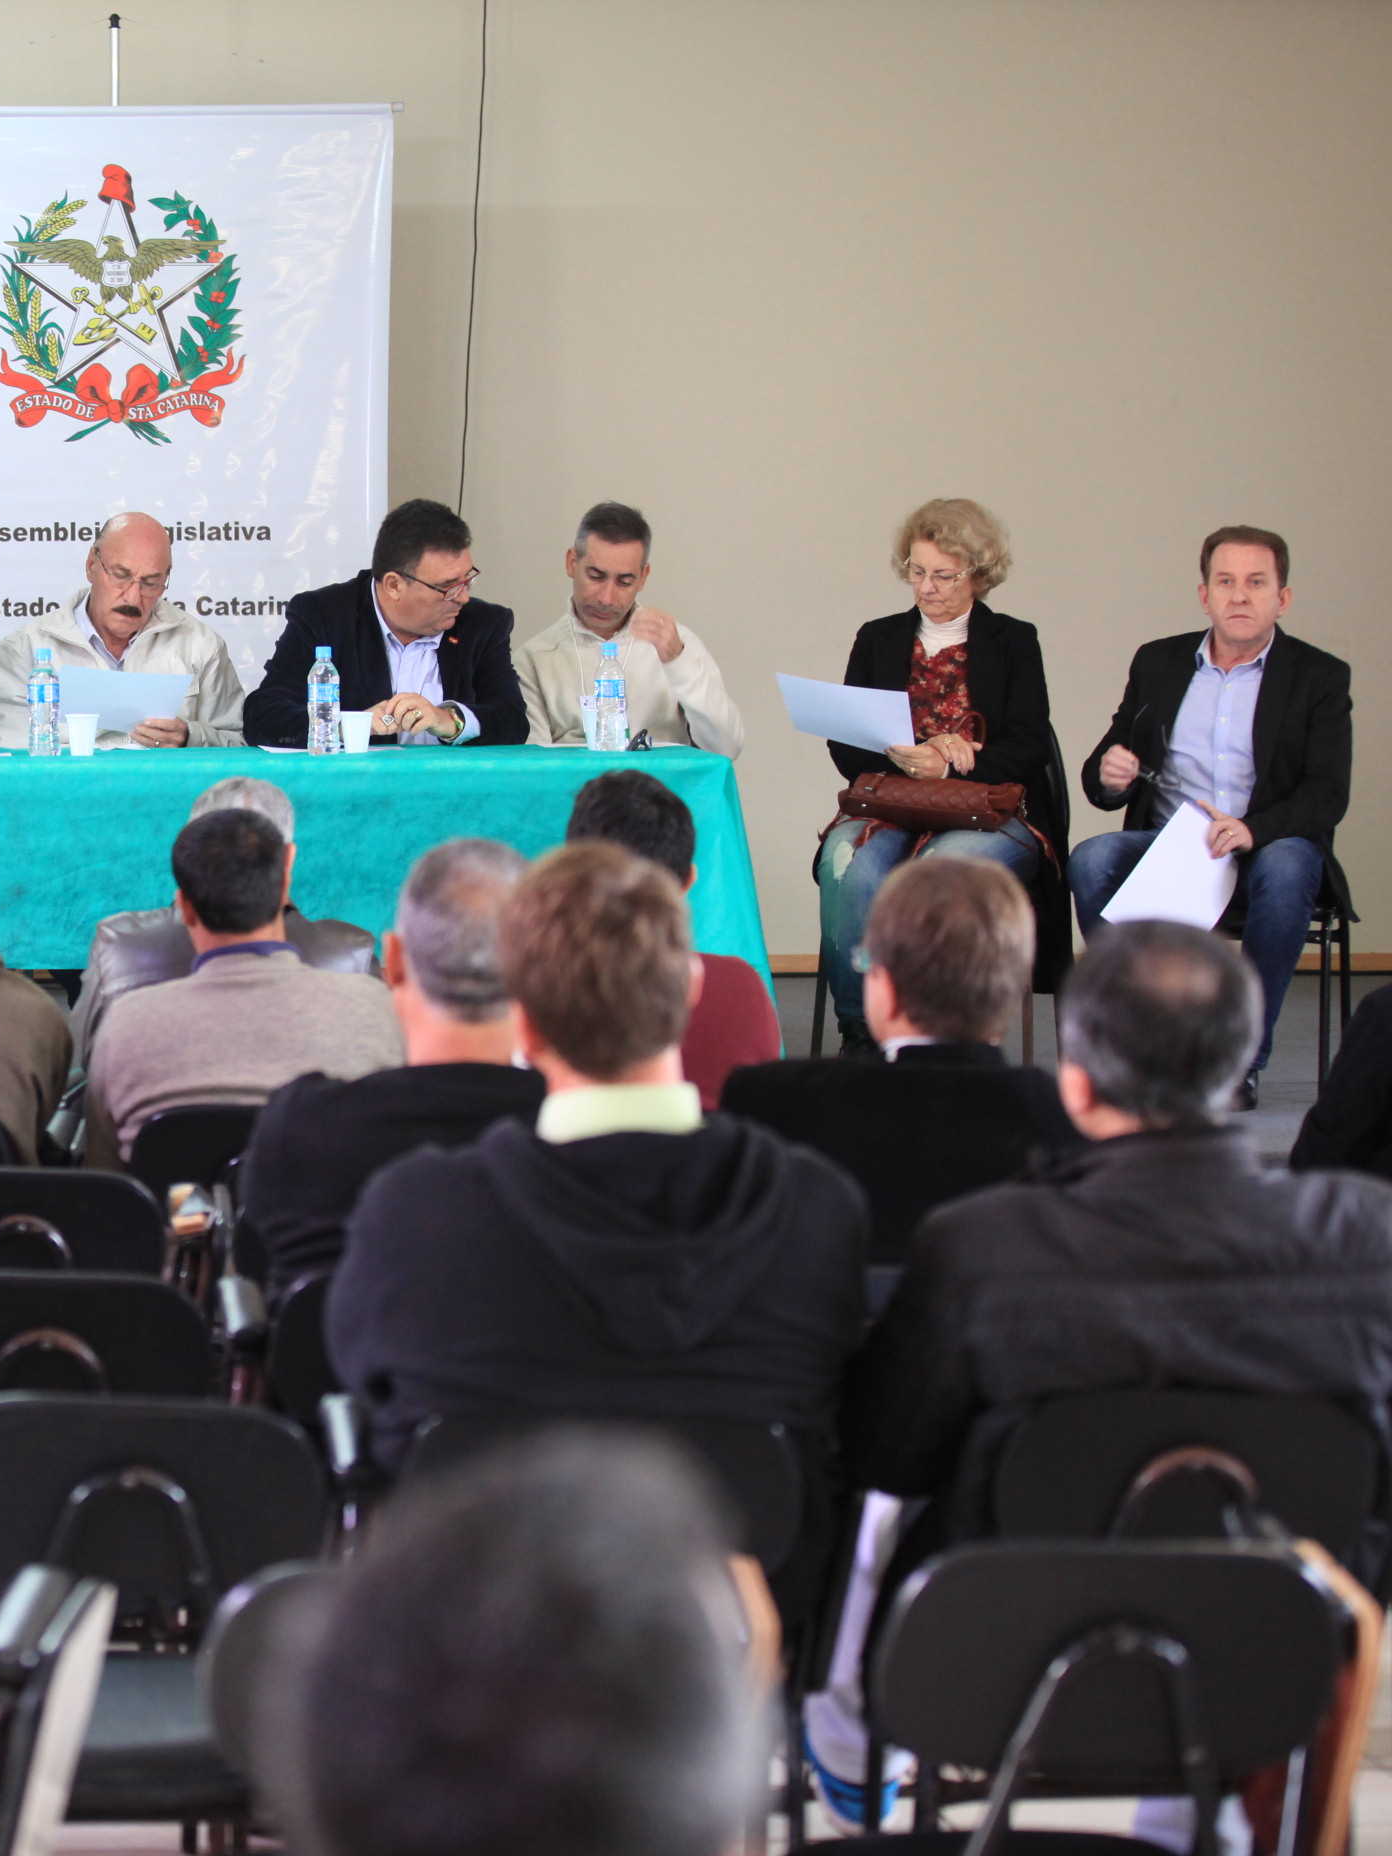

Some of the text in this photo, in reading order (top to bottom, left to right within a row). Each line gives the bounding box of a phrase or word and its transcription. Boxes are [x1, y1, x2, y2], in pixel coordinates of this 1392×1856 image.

[15, 394, 220, 420] ESTADO DE STA. CATARINA
[196, 596, 290, 616] Catarin
